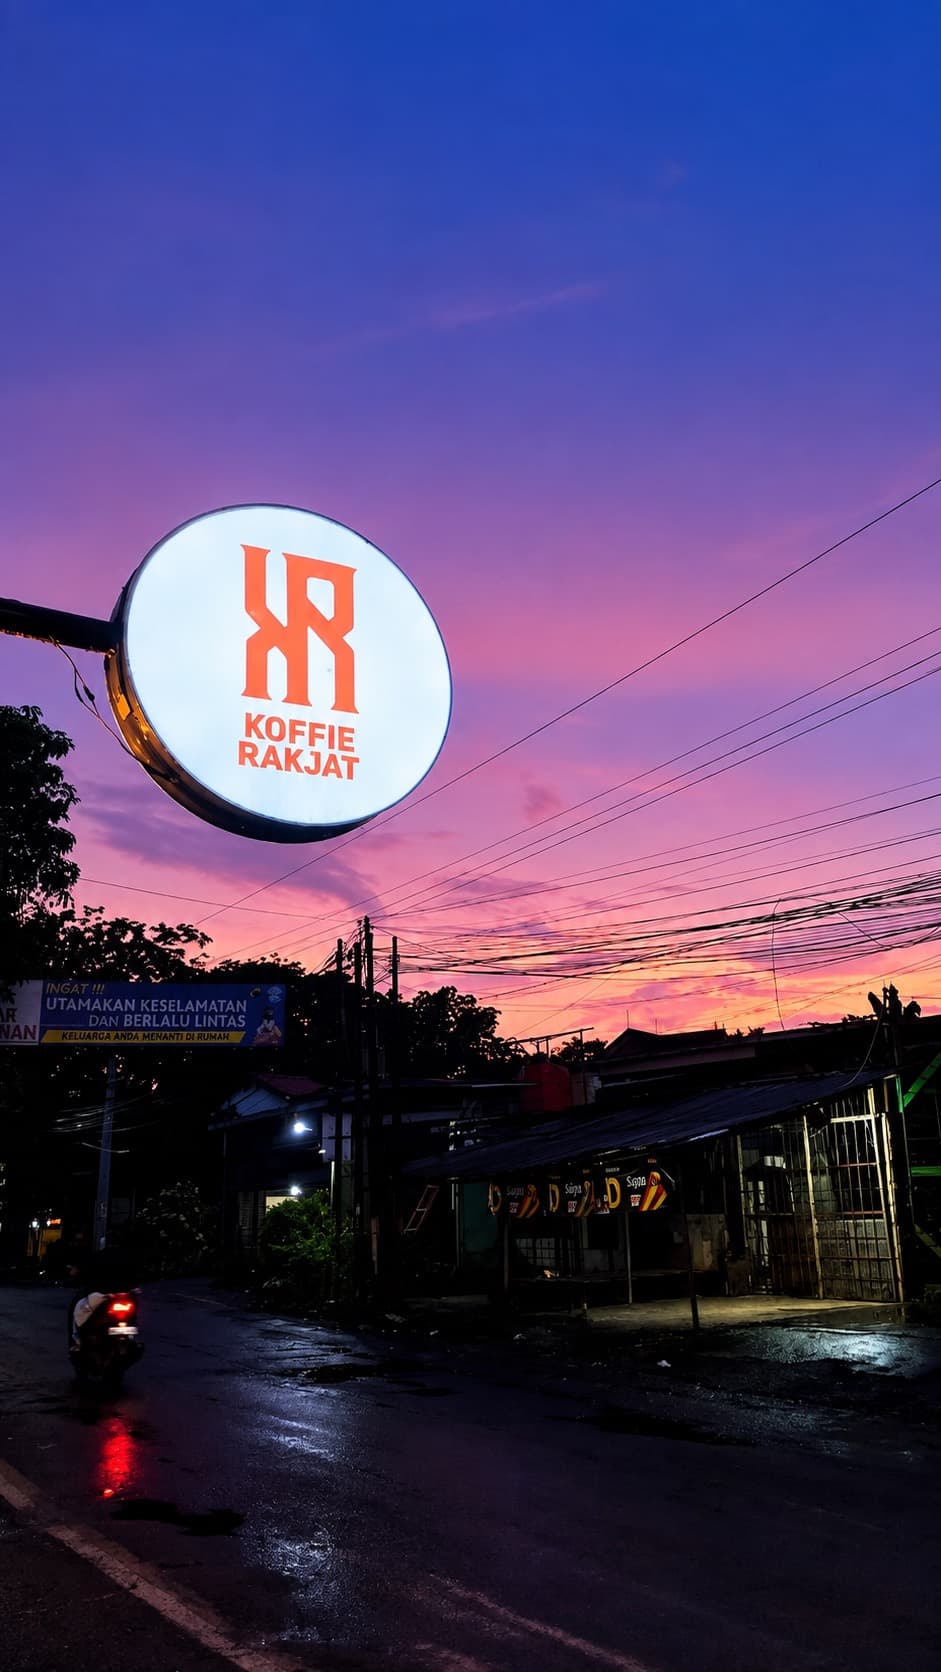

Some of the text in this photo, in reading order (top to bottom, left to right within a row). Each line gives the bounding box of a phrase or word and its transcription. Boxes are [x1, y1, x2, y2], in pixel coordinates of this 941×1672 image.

[244, 712, 355, 753] KOFFIE
[238, 740, 360, 781] RAKJAT
[46, 983, 105, 995] INGAT !!!
[46, 997, 247, 1013] UTAMAKAN KESELAMATAN
[88, 1014, 246, 1028] DAN BERLALU LINTAS
[61, 1031, 230, 1041] KELUARGA ANDA MENANTI DI RUMAH
